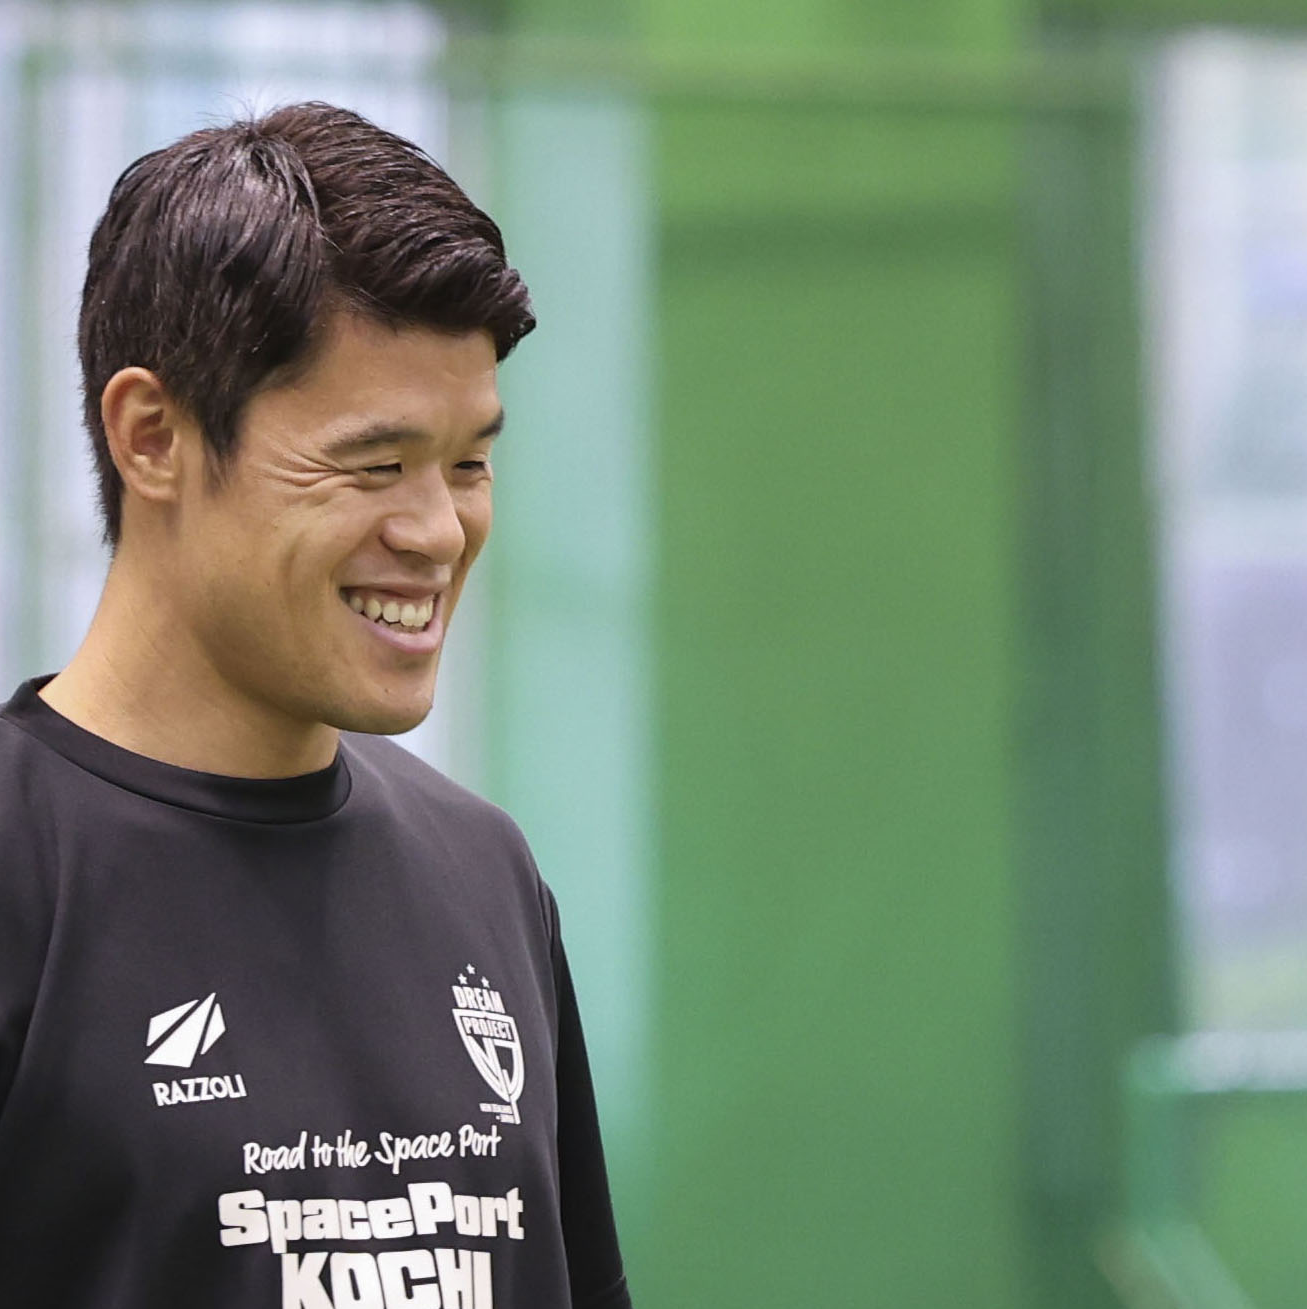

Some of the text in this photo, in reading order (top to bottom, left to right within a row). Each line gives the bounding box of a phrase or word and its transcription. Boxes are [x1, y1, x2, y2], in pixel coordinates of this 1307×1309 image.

[451, 985, 506, 1014] DREAM
[460, 1015, 514, 1041] PROJECT
[152, 1073, 247, 1107] RAZZOLI
[243, 1130, 308, 1175] Road
[336, 1129, 372, 1169] the
[374, 1131, 455, 1175] Space
[458, 1124, 502, 1158] Port
[217, 1181, 525, 1254] SpacePort
